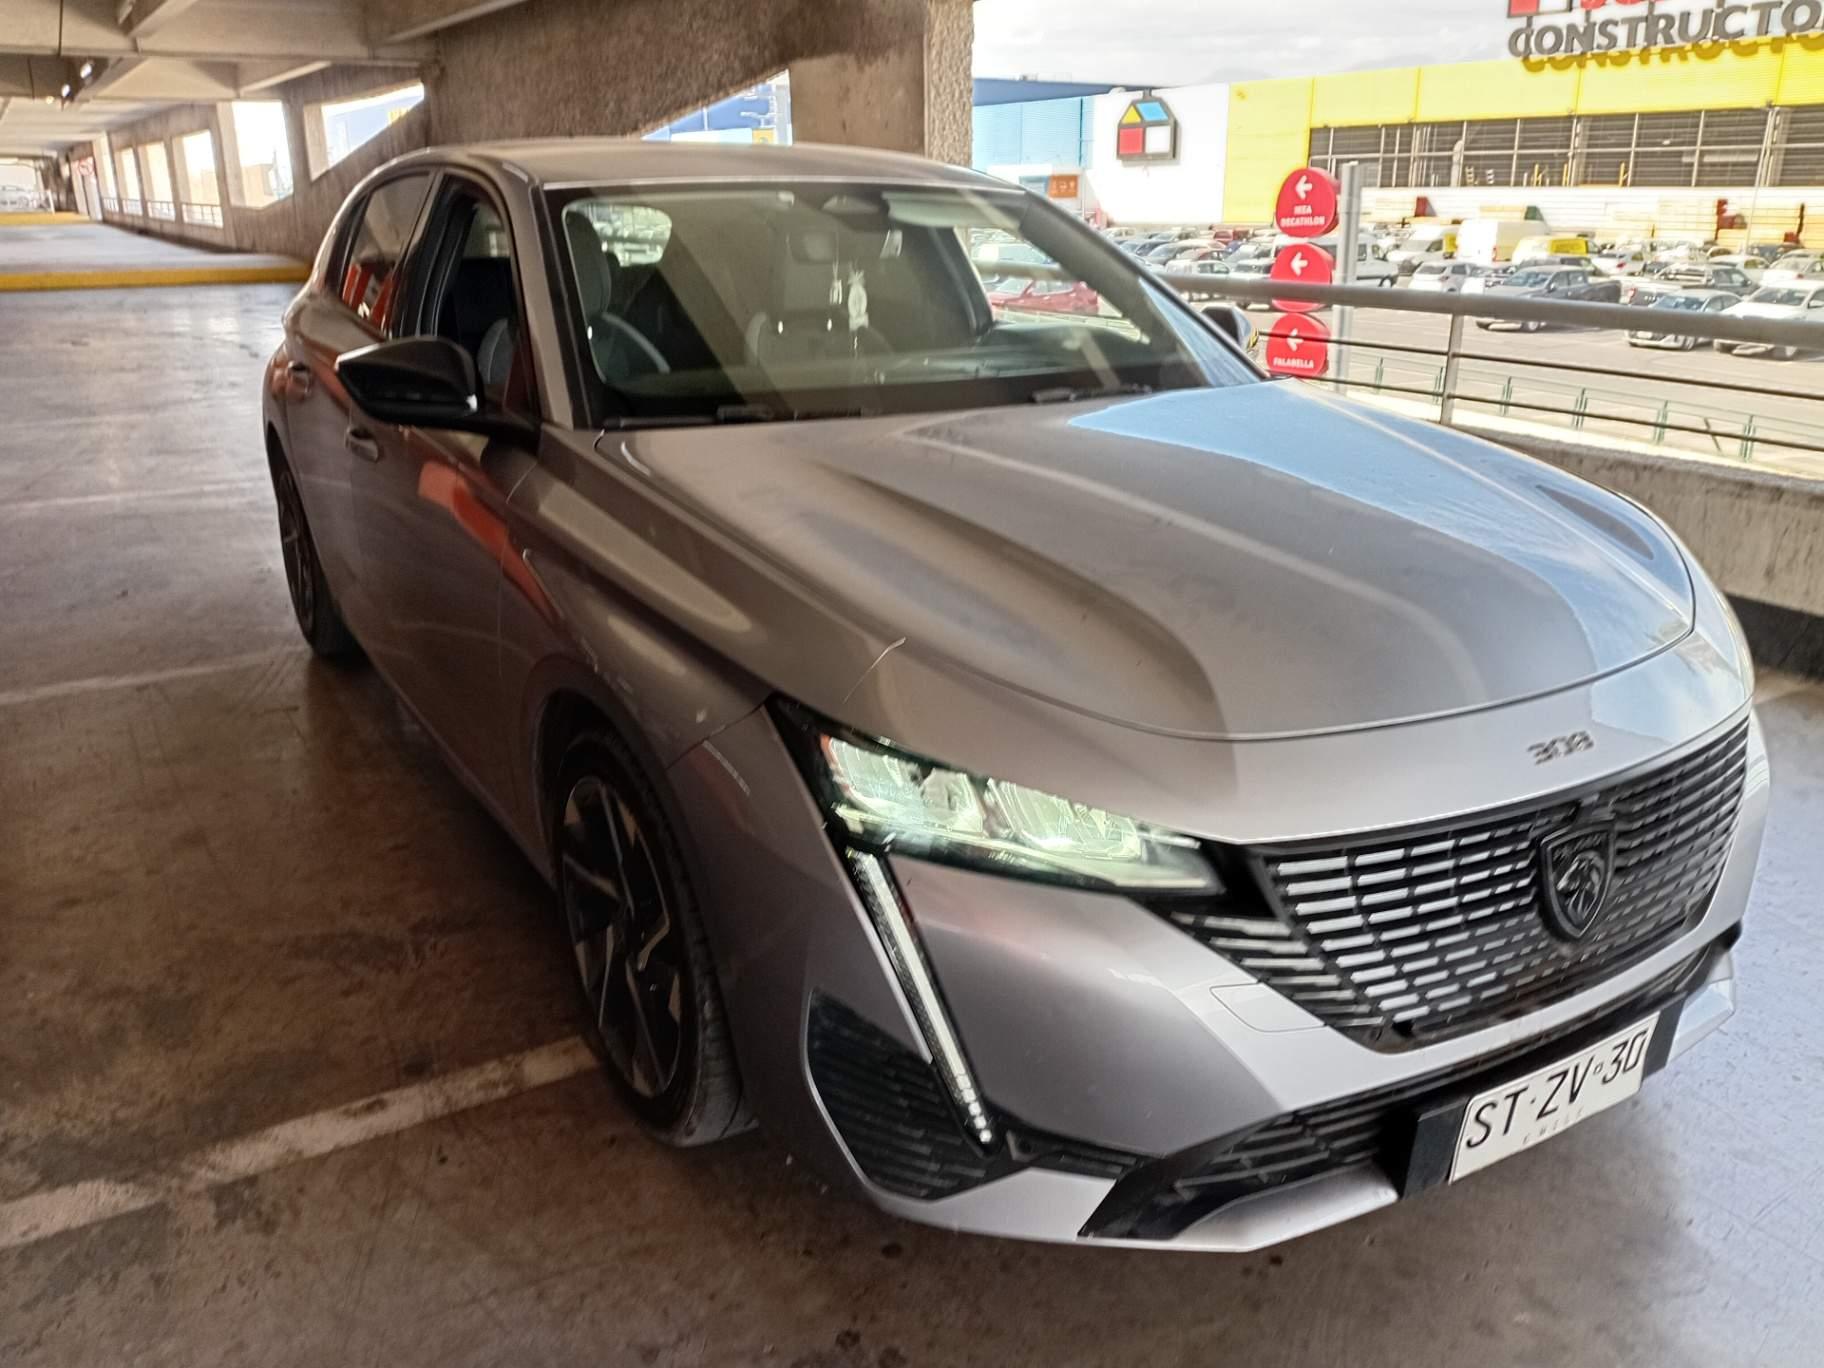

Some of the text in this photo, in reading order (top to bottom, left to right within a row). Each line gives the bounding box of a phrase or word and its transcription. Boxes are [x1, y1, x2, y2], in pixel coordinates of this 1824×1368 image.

[1508, 0, 1824, 57] CONSTRUCTO
[1280, 216, 1325, 227] DECATHLON
[1273, 357, 1314, 368] FALABELLA
[1527, 730, 1595, 766] 308
